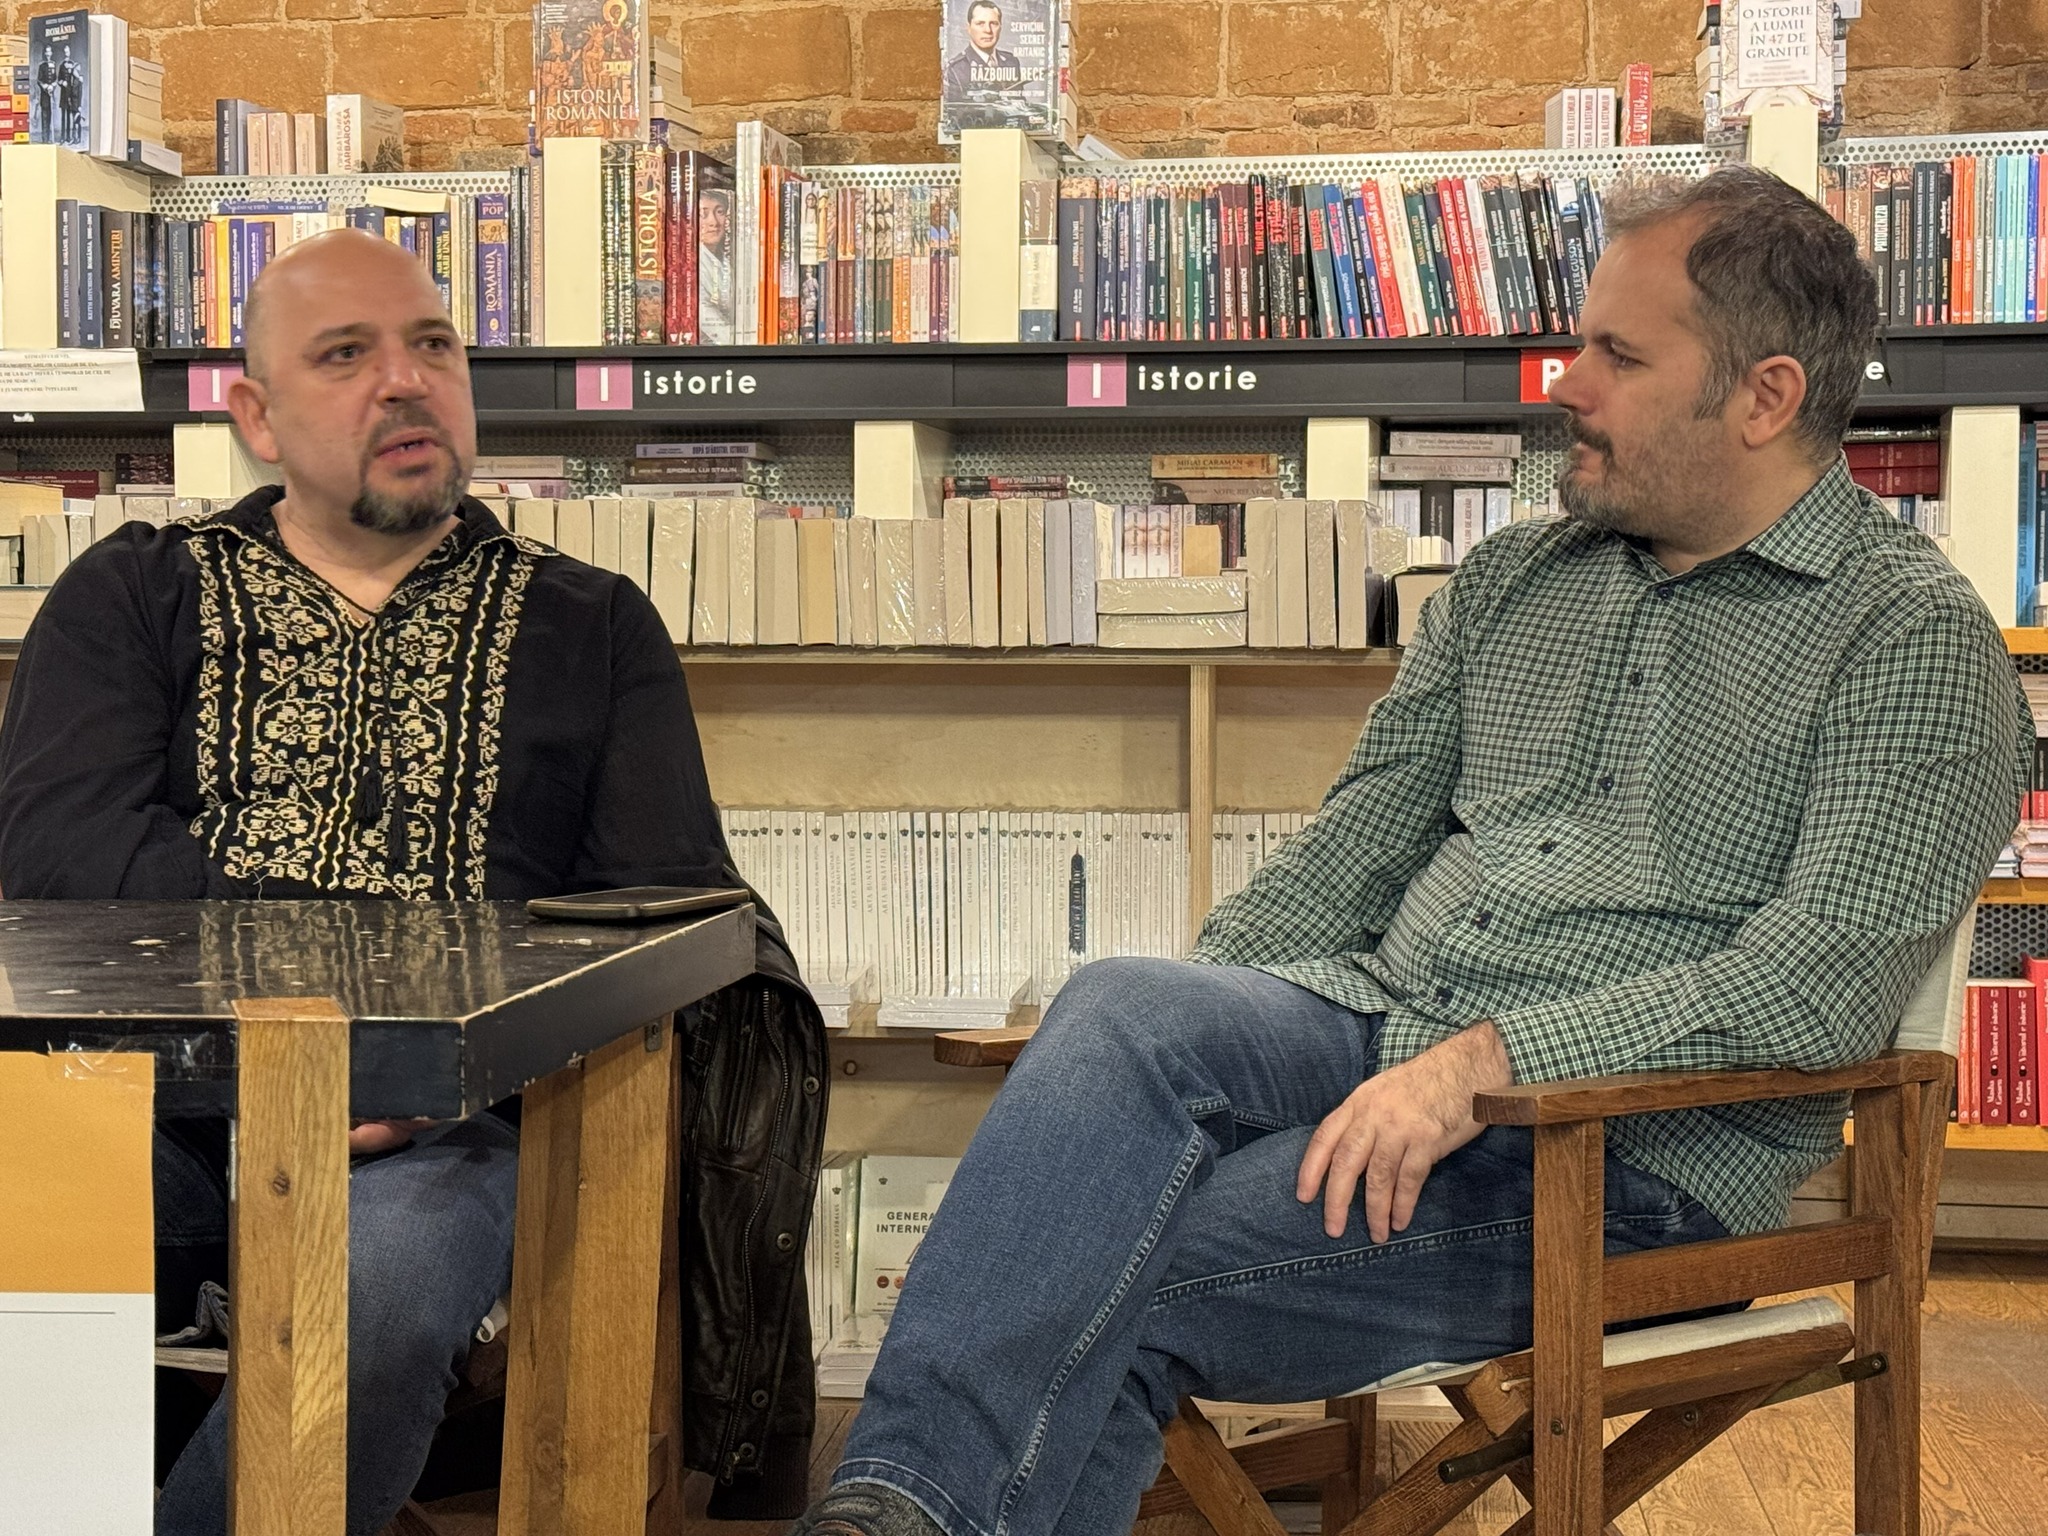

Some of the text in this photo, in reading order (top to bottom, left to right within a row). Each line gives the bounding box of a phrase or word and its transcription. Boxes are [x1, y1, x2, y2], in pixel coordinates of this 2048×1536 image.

[1743, 6, 1812, 18] O ISTORIE
[1751, 20, 1804, 32] A LUMII
[1020, 34, 1045, 45] SECRET
[1769, 34, 1784, 44] 47
[1788, 33, 1805, 43] DE
[1746, 45, 1810, 60] GRANIȚE
[971, 65, 1045, 81] RĂZBOIUL RECE
[557, 88, 623, 104] ISTORIA
[343, 108, 351, 171] BARBAROSSA
[482, 206, 504, 216] POP
[1443, 190, 1454, 213] RUSIEI
[1456, 190, 1466, 213] RUSIEI
[638, 188, 658, 276] ISTORIA
[1310, 209, 1323, 250] NEMESIS
[1874, 205, 1888, 252] PATOGENEZA
[442, 231, 450, 254] UNIRI
[1567, 238, 1582, 288] FERGUSON
[110, 229, 122, 329] DJUVARA AMINTIRI
[483, 249, 498, 312] ROMÂNIA
[1898, 270, 1906, 316] Octavian Buda
[212, 369, 221, 403] I
[600, 367, 757, 402] I istorie
[1093, 363, 1257, 398] I istorie
[2019, 1002, 2027, 1026] istorie
[1989, 1032, 1999, 1062] Viitorul
[2018, 1033, 2027, 1063] Viitorul
[887, 1211, 935, 1221] GENERA
[876, 1223, 928, 1234] INTERNE
